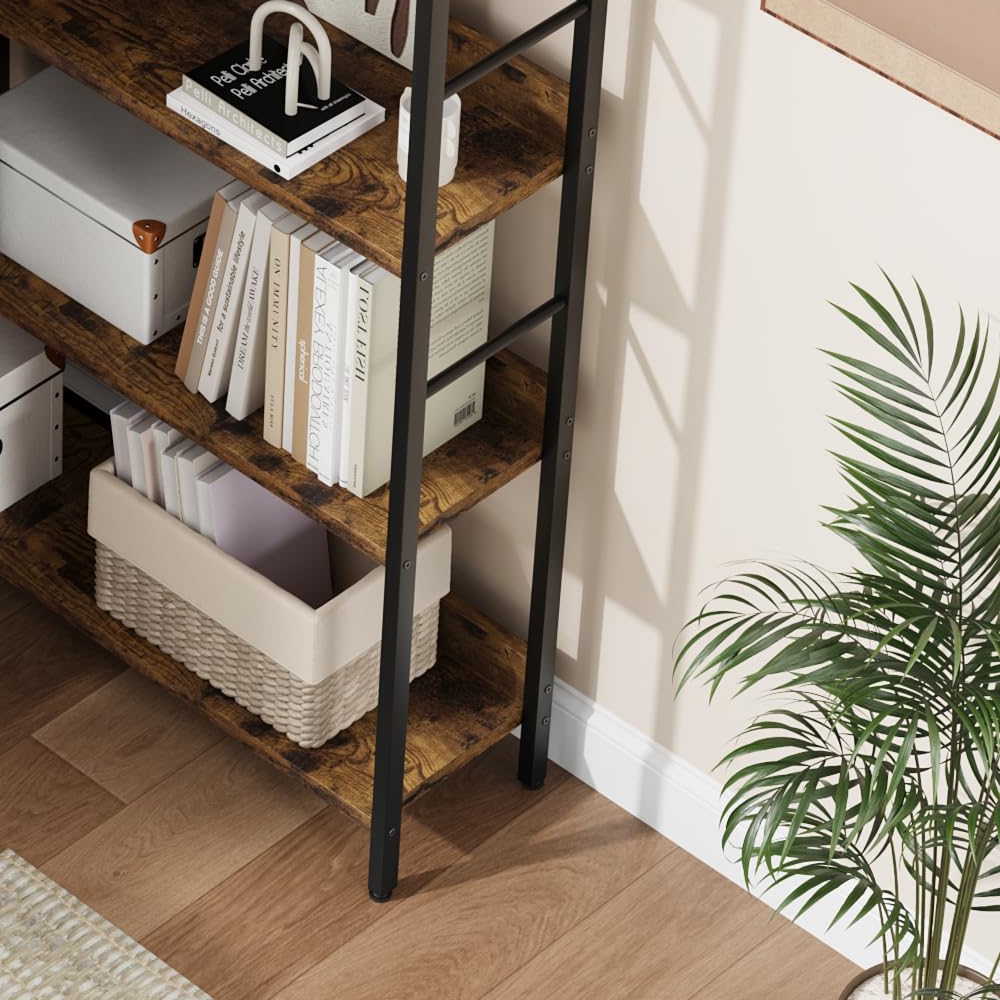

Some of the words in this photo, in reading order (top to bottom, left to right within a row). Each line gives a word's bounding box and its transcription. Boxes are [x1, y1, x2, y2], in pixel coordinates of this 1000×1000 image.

[179, 104, 222, 137] Hexagons
[184, 78, 212, 105] Pelli
[218, 102, 283, 152] Architects
[230, 81, 258, 100] Pelli
[197, 324, 207, 345] THIS
[205, 278, 217, 306] GOOD
[212, 247, 224, 278] GUIDE
[216, 321, 225, 333] for
[221, 263, 239, 313] sustainable
[232, 230, 247, 264] lifestyle
